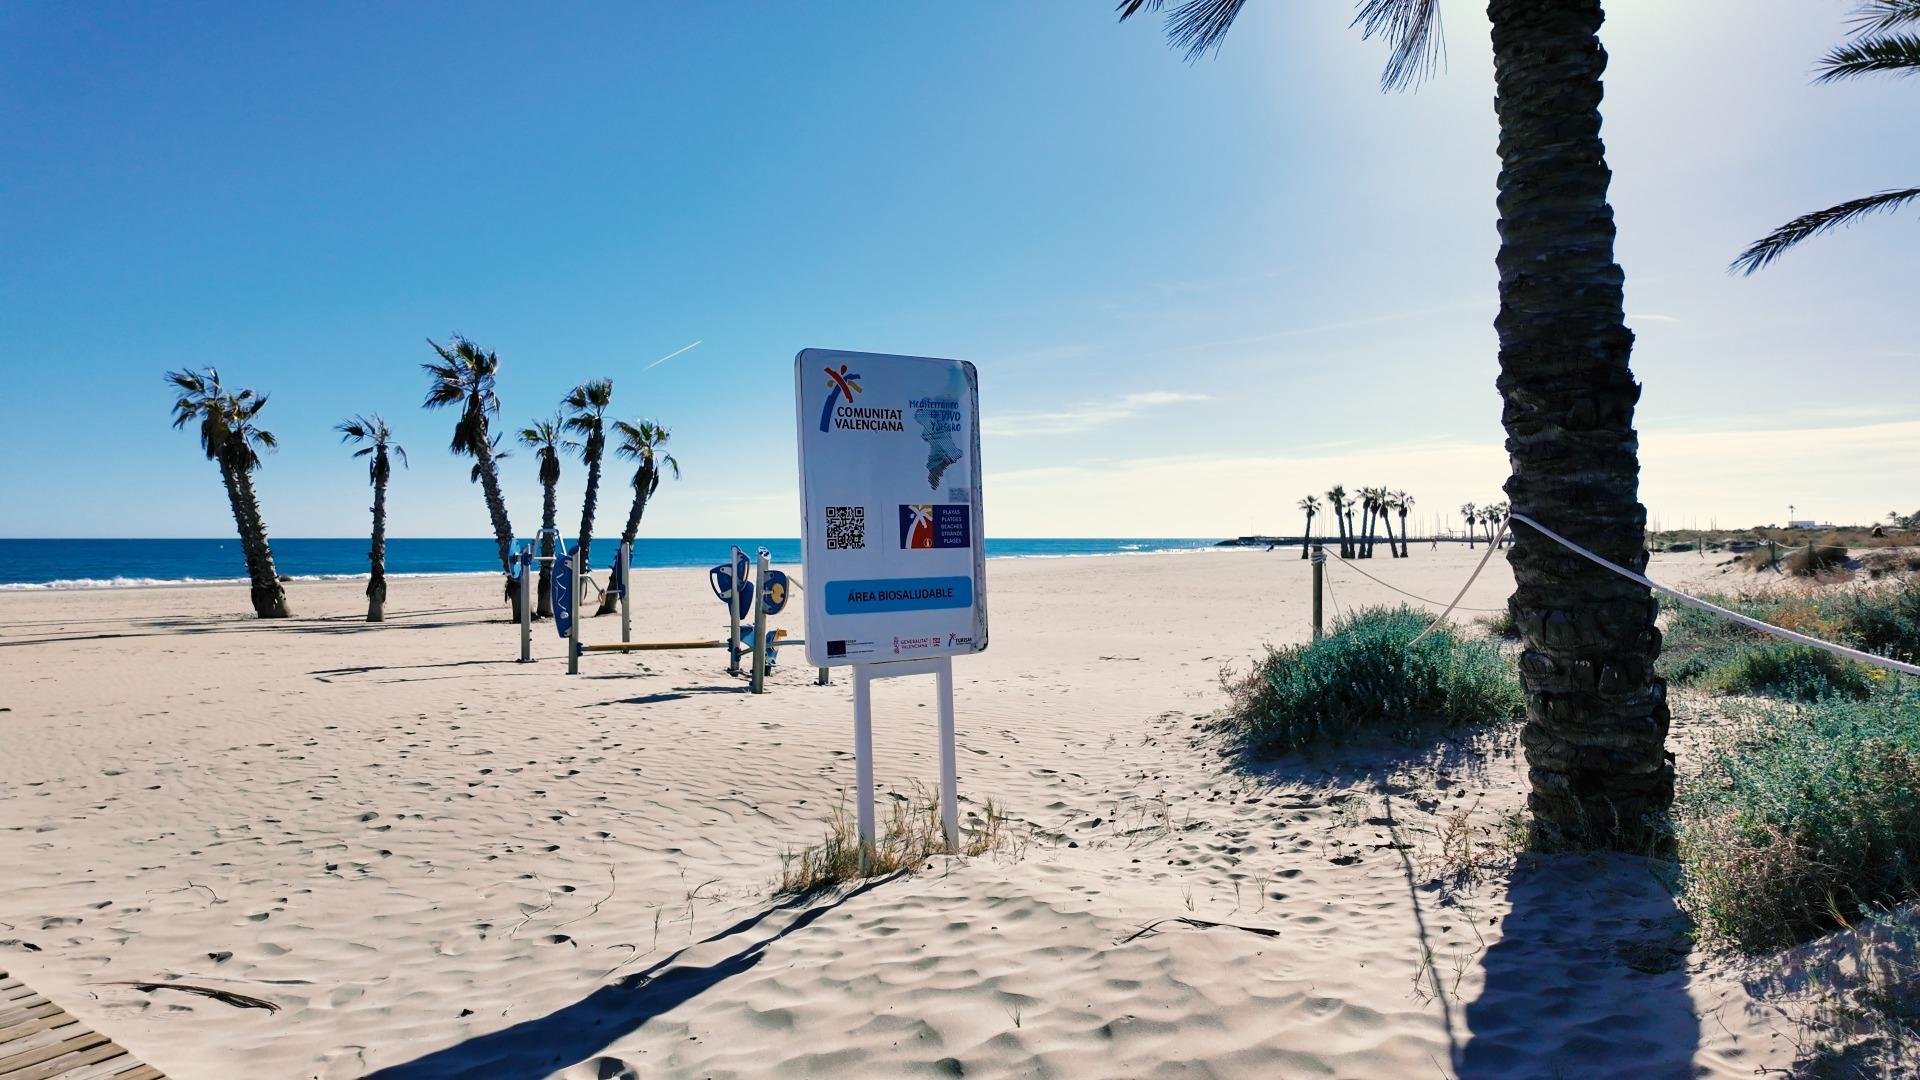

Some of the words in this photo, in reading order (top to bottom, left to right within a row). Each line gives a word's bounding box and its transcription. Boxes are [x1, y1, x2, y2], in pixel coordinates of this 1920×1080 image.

[837, 406, 902, 420] COMUNITAT
[835, 418, 904, 432] VALENCIANA
[848, 589, 876, 602] ÁREA
[878, 588, 953, 601] BIOSALUDABLE
